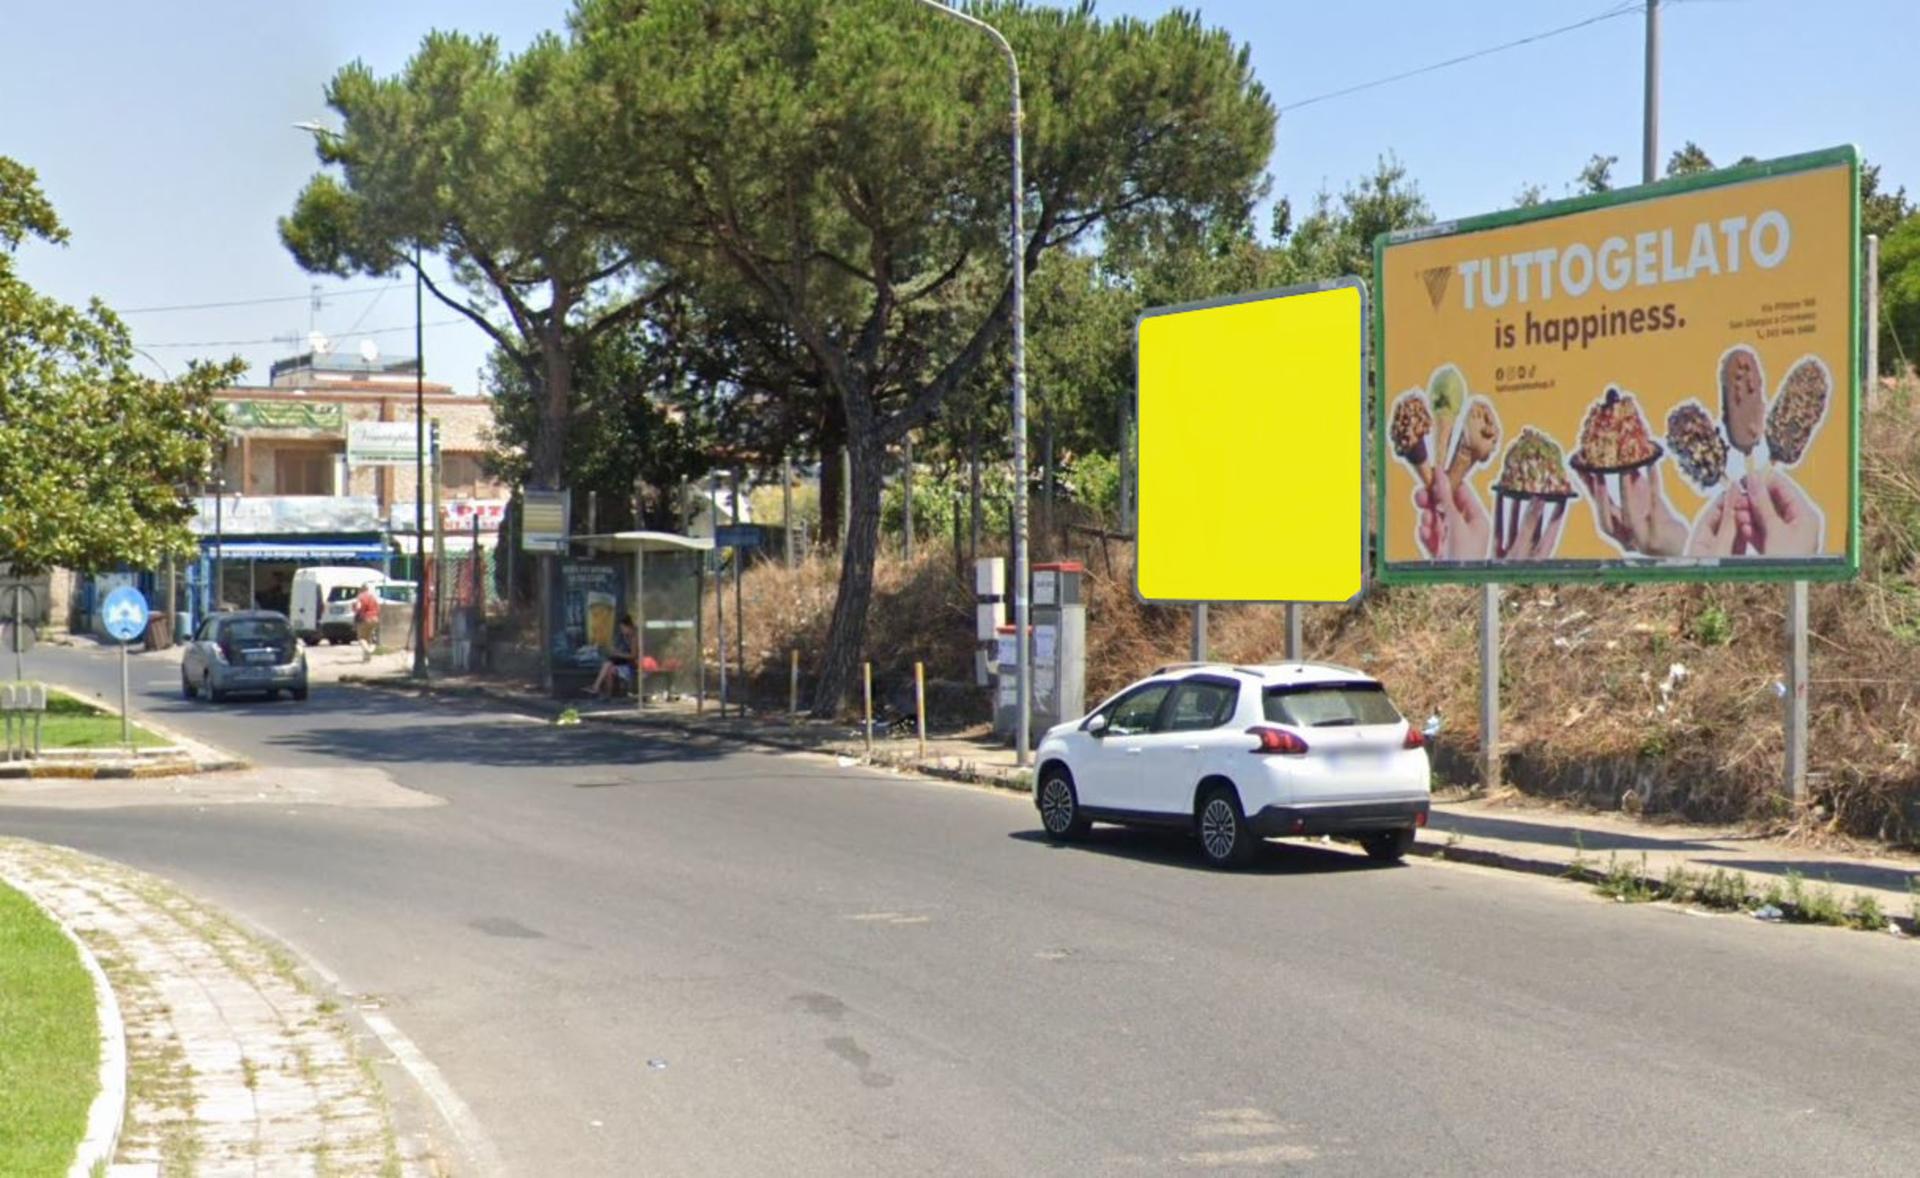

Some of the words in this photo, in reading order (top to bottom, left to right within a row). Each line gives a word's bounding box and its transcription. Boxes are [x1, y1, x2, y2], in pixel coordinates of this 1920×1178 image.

[1458, 210, 1791, 310] TUTTOGELATO
[1494, 318, 1516, 349] is
[1525, 304, 1687, 351] happiness.
